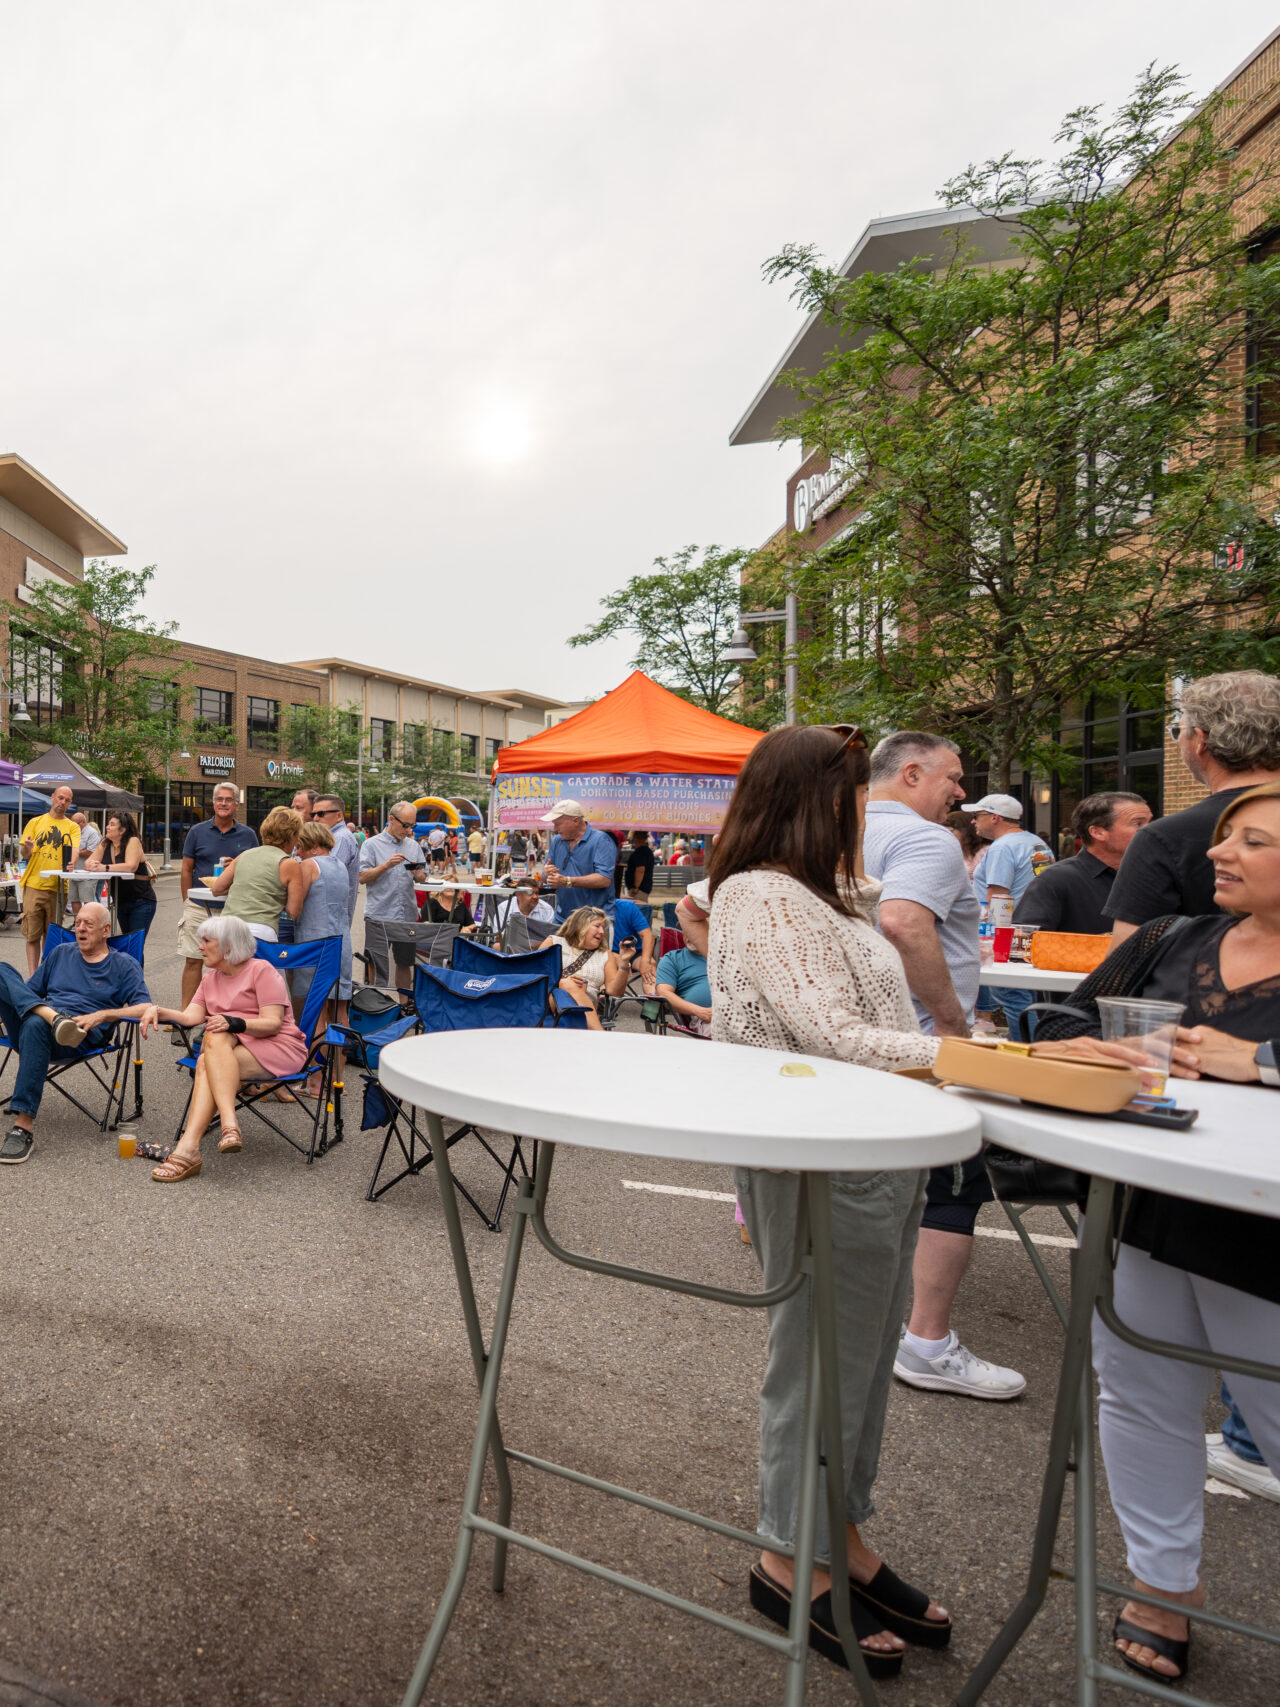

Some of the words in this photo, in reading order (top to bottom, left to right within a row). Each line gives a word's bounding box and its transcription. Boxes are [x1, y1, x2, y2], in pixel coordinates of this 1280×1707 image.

[268, 760, 280, 777] On
[282, 762, 304, 776] Pointe
[498, 776, 563, 799] SUNSET
[567, 776, 630, 787] GATORADE
[634, 777, 643, 787] &
[649, 777, 691, 788] WATER
[697, 778, 737, 789] STATI
[581, 788, 632, 798] DONATION
[636, 789, 669, 799] BASED
[616, 801, 633, 809] ALL
[638, 801, 700, 811] DONATIONS
[603, 811, 616, 820] GO
[620, 811, 633, 820] TO
[637, 812, 662, 821] BEST
